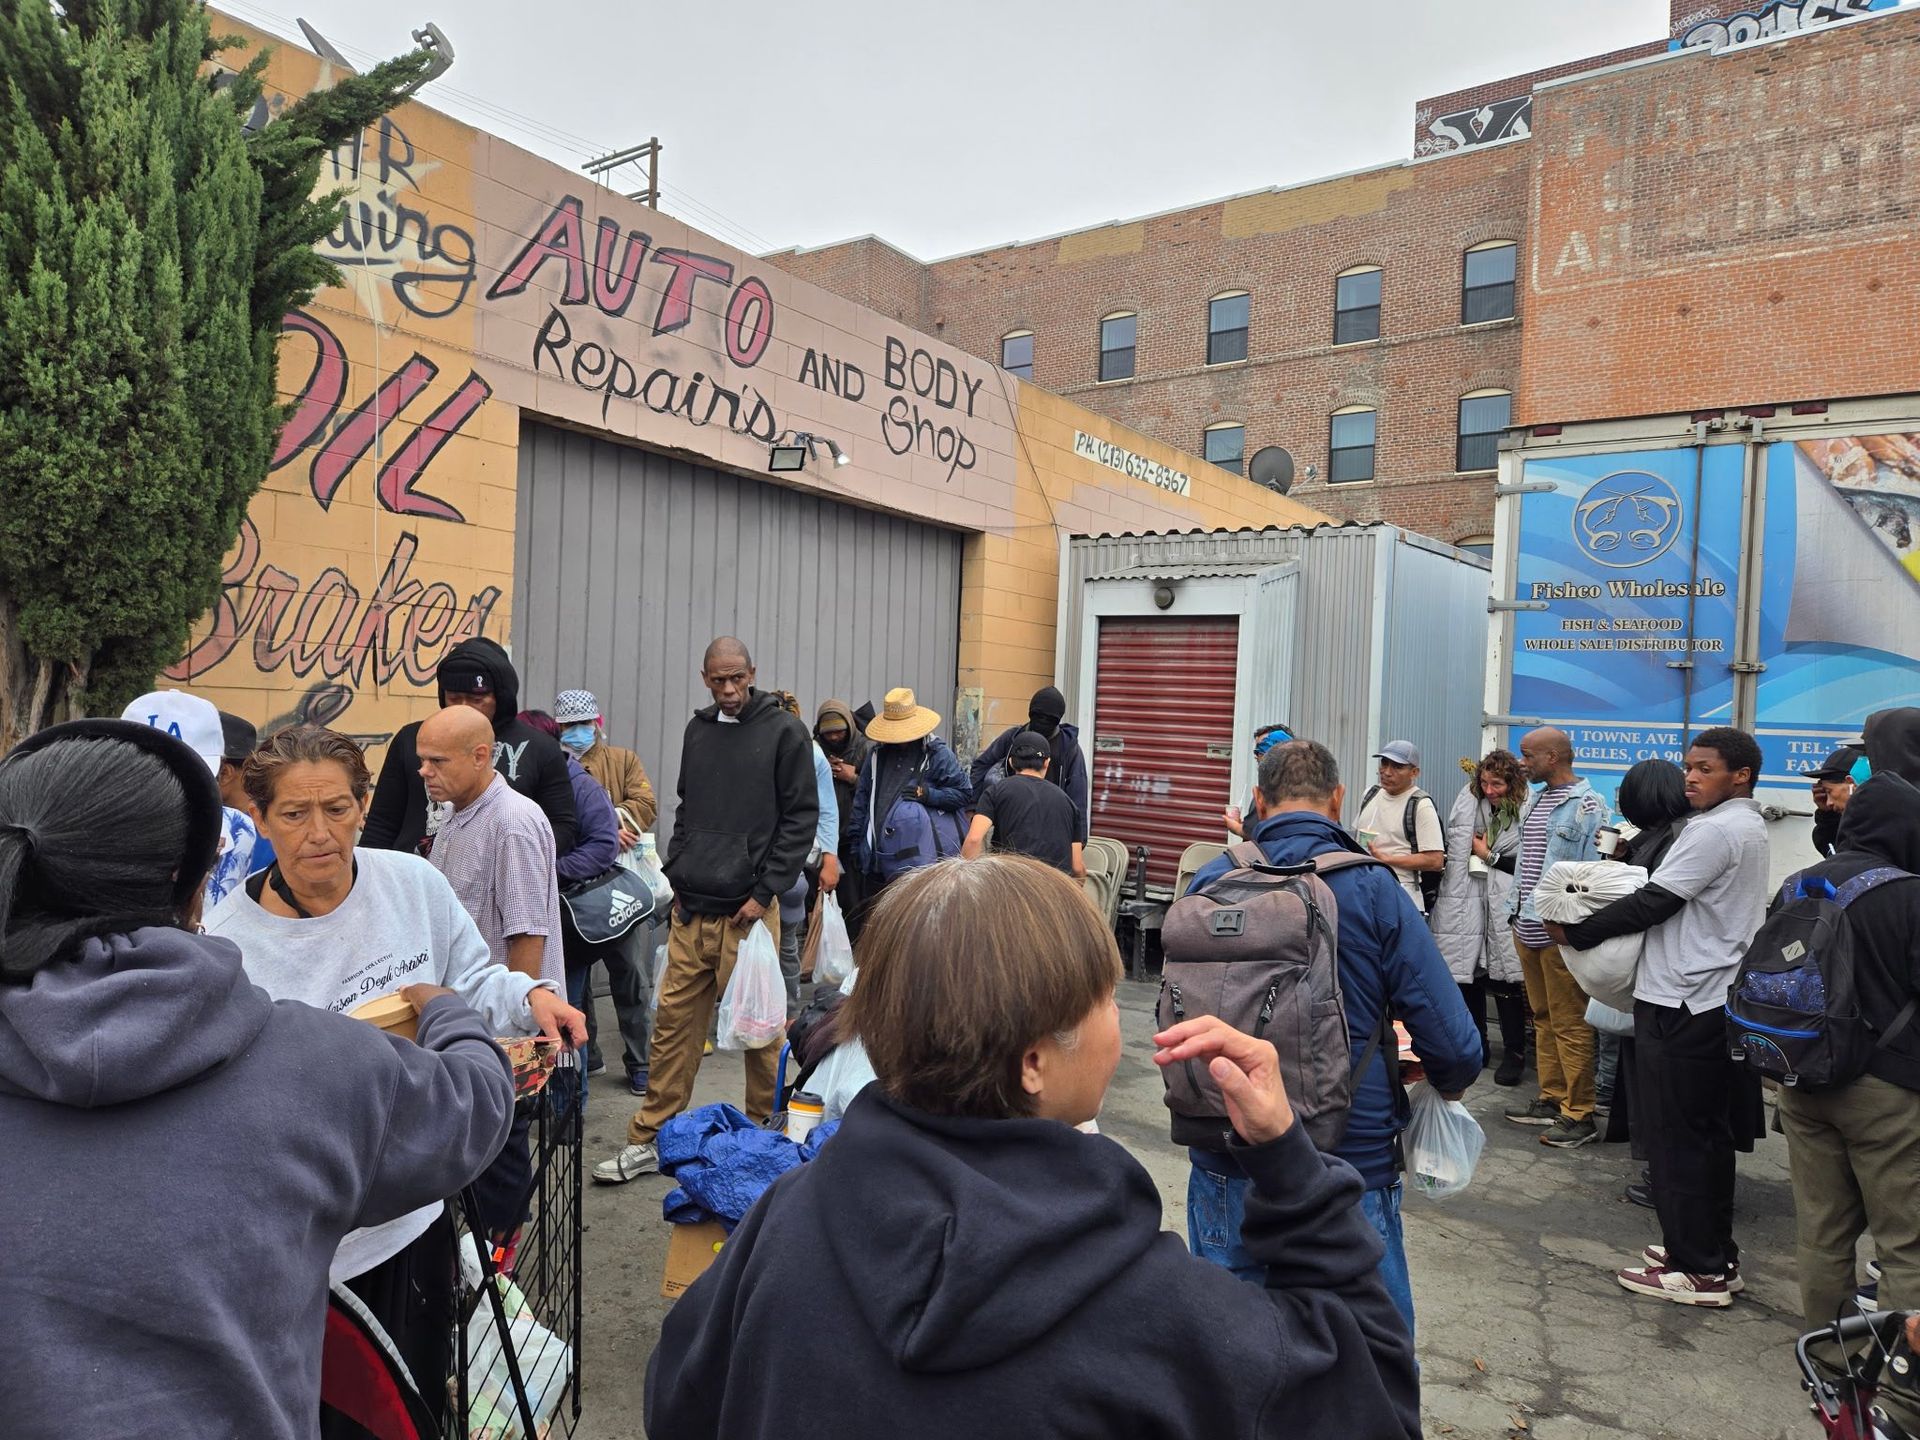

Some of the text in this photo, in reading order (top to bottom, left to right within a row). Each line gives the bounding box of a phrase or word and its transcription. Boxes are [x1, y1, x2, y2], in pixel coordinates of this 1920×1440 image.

[485, 194, 983, 417] AUTO AND BODY
[881, 396, 976, 483] Shop
[1076, 433, 1188, 495] PH. (213) 632-8367
[1531, 582, 1601, 600] Fishco
[1562, 618, 1683, 631] FISH & SEAFOOD
[1525, 639, 1576, 651] WHOLE
[1579, 639, 1614, 651] SALE
[1581, 730, 1641, 743] TOWNE
[1644, 733, 1683, 745] AVE.
[1636, 749, 1660, 760] CA
[1788, 741, 1830, 755] TEL:
[608, 899, 643, 928] adidas
[361, 964, 394, 995] Degli
[394, 948, 430, 978] Artisti
